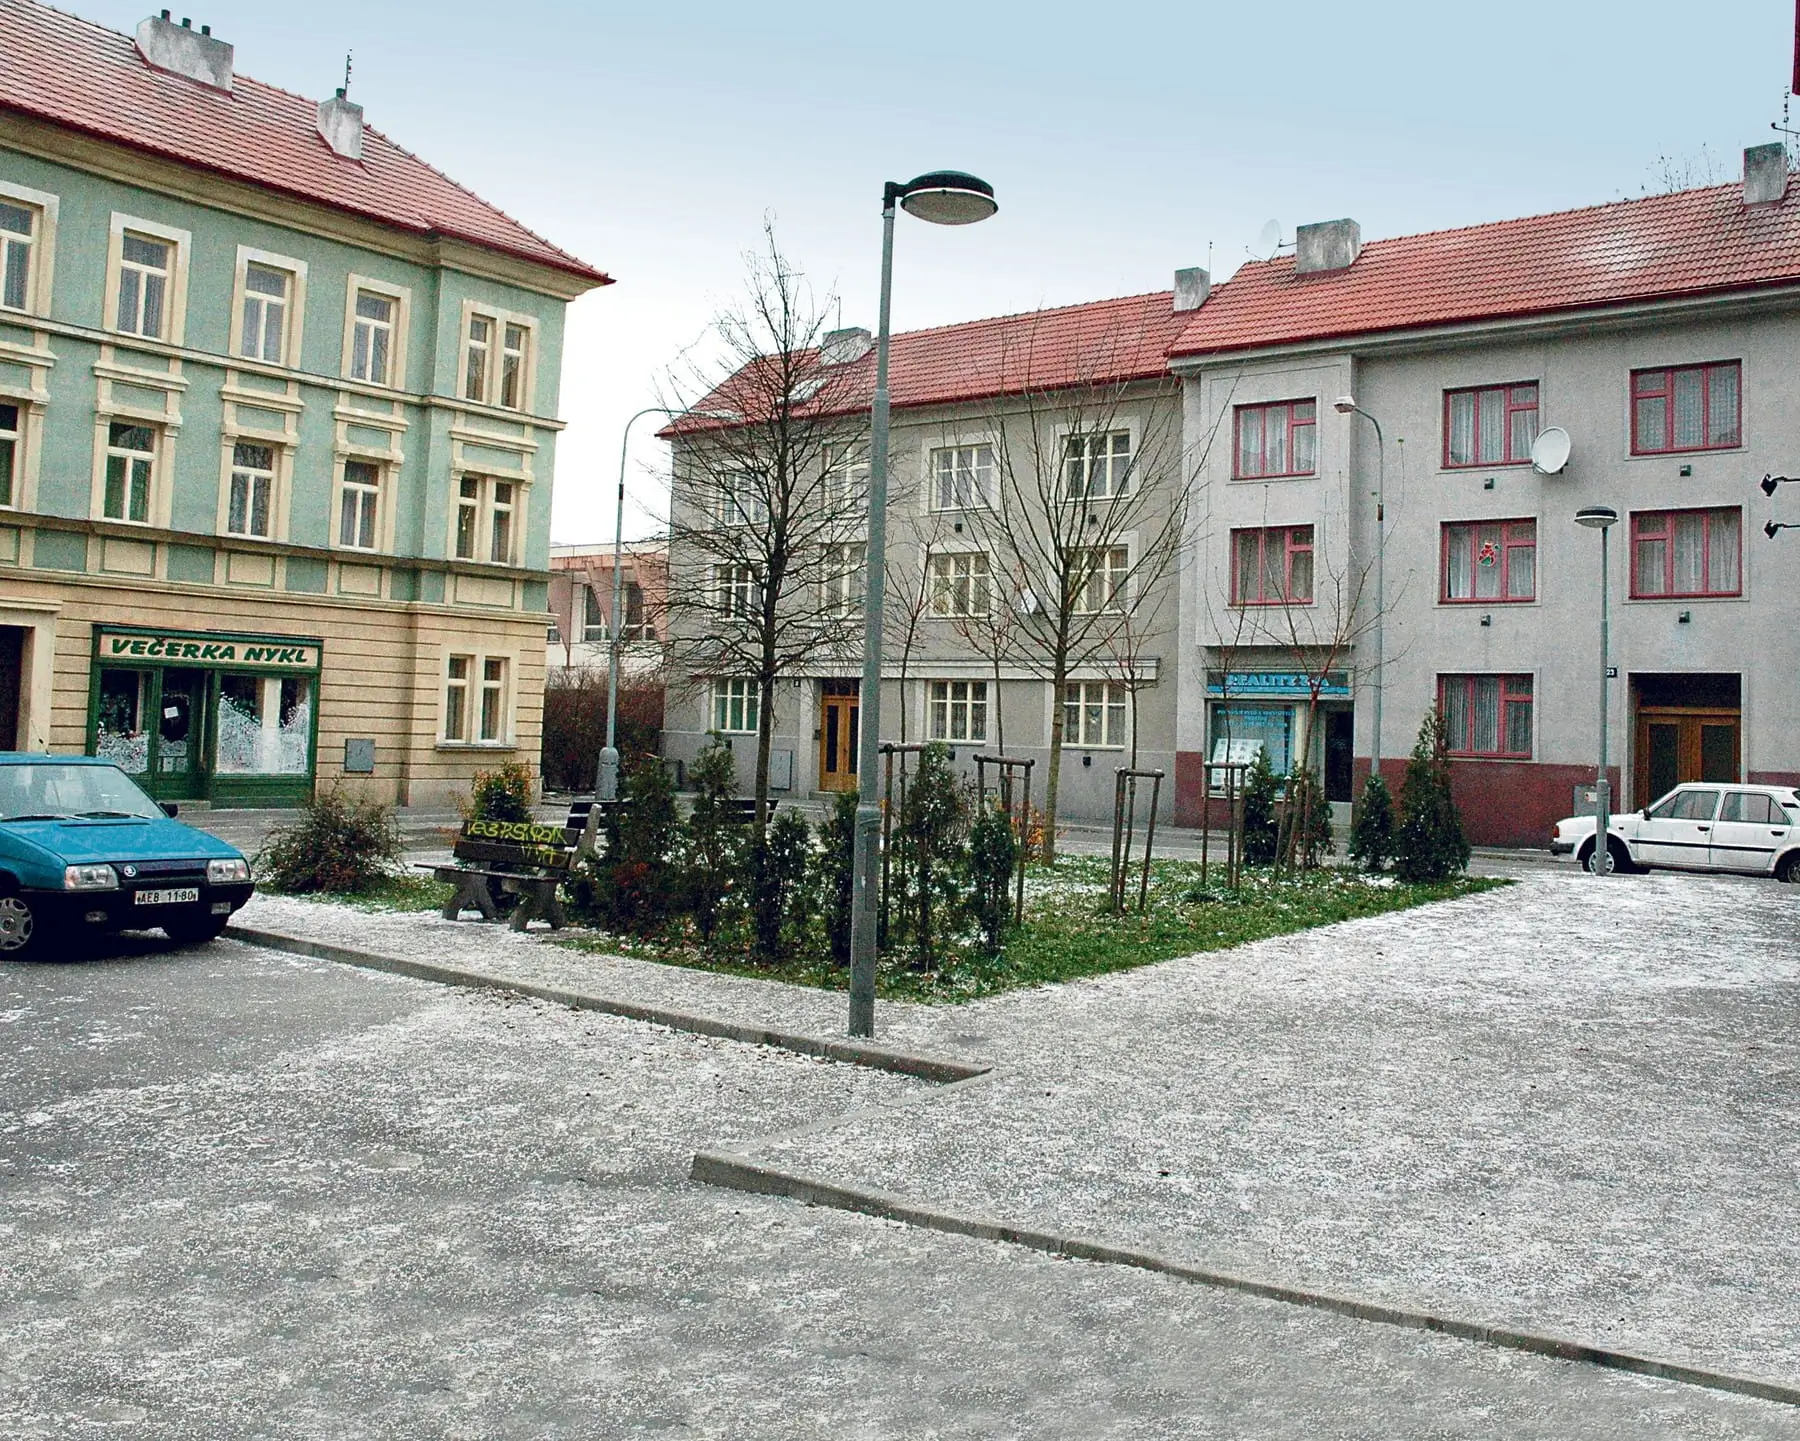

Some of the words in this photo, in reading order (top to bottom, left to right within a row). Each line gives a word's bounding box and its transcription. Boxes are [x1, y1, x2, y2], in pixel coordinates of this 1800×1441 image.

[111, 637, 236, 660] VEČERKA
[243, 647, 308, 663] NYKL
[141, 892, 160, 904] AEB
